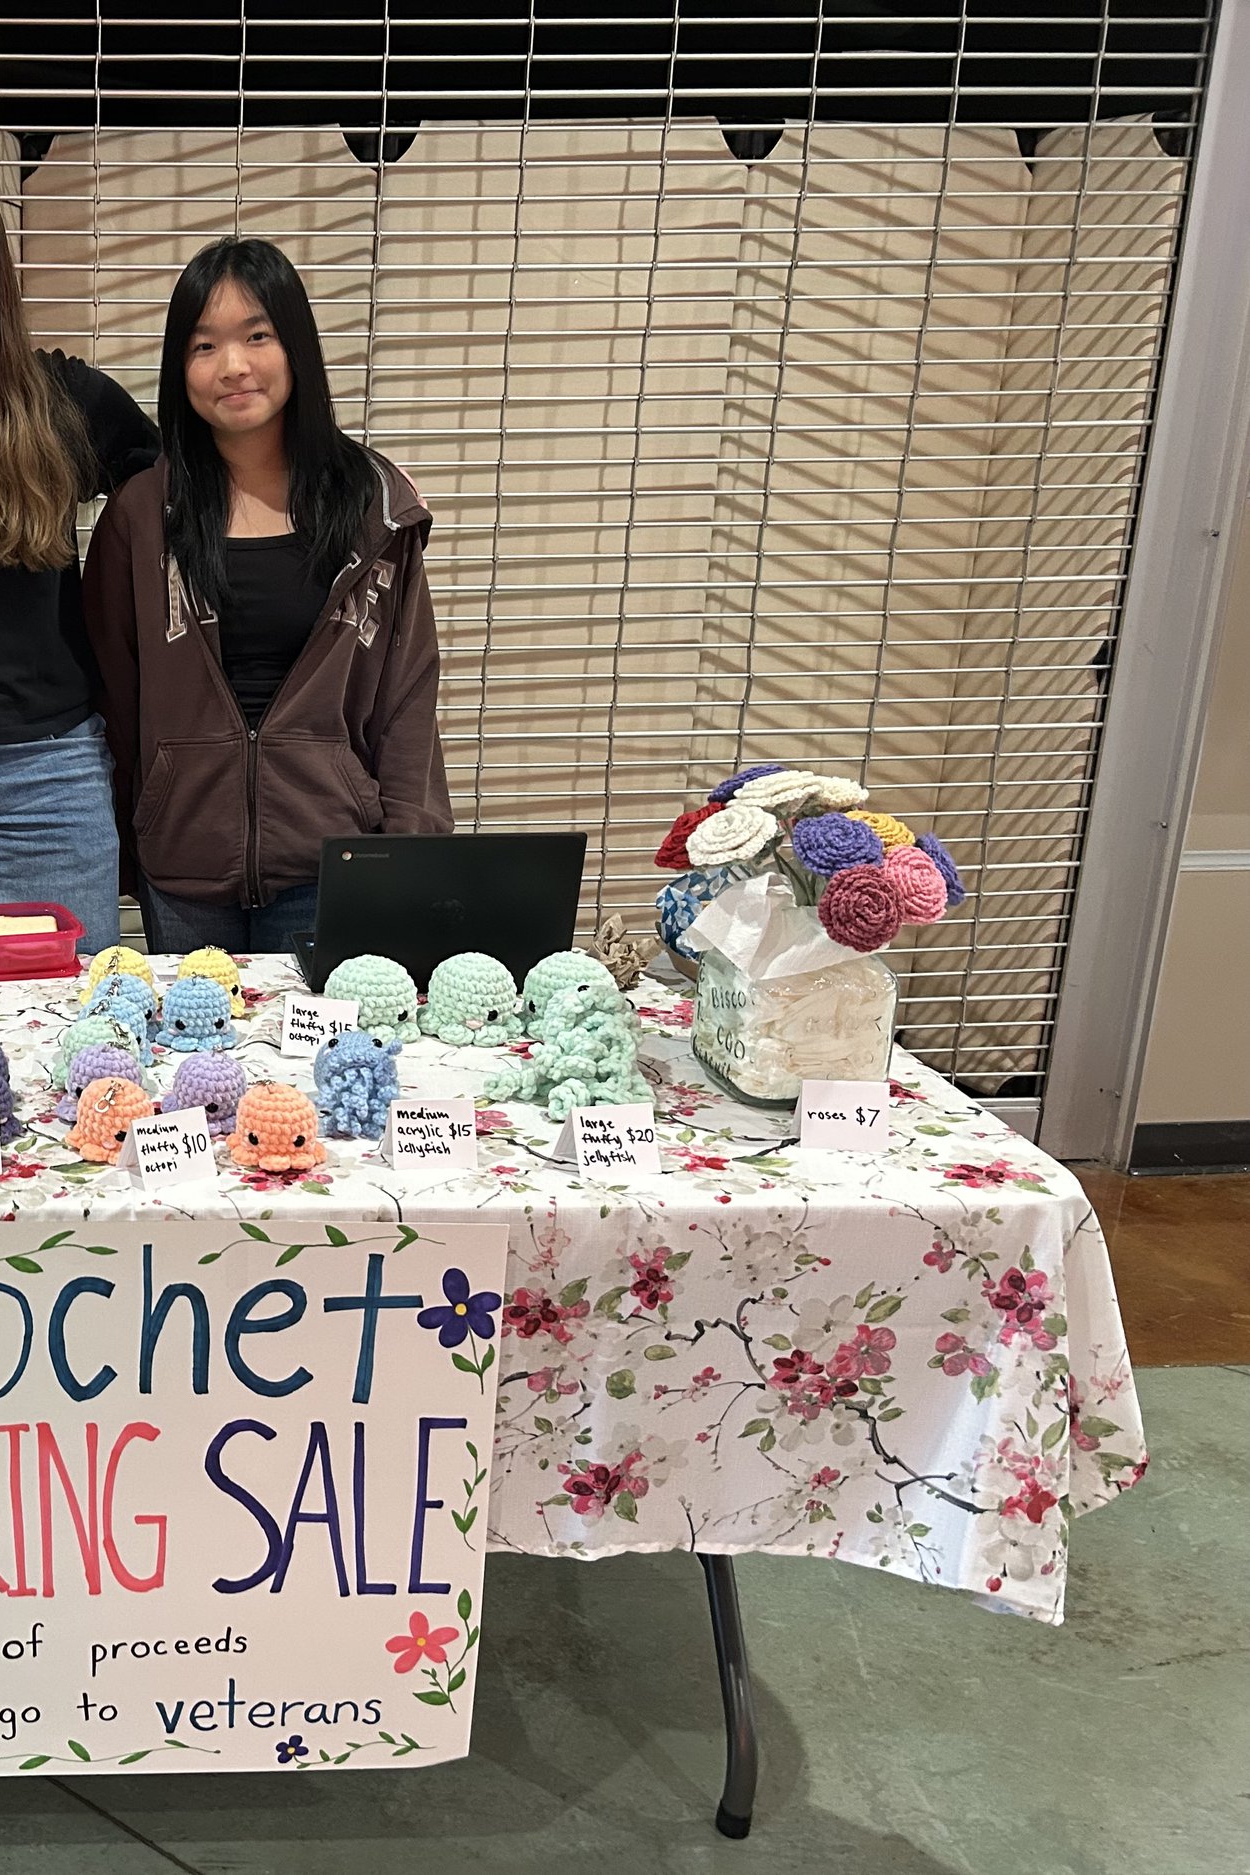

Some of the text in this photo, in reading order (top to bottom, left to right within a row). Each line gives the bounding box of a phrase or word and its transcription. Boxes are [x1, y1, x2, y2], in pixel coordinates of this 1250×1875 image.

[291, 1004, 319, 1022] large
[290, 1018, 353, 1036] fluffy $15
[288, 1032, 320, 1046] octopi
[396, 1106, 450, 1120] medium
[807, 1106, 881, 1128] roses $7
[136, 1124, 179, 1136] medium
[397, 1122, 473, 1140] acrylic $15
[579, 1115, 615, 1133] large
[141, 1132, 207, 1159] fluffy $10
[581, 1127, 654, 1149] fluffy $20
[398, 1140, 451, 1158] jellyfish
[583, 1148, 636, 1168] jellyfish
[145, 1159, 178, 1173] octopi
[204, 1417, 468, 1596] SALE
[0, 1622, 45, 1662] of
[88, 1626, 250, 1678] proceeds
[75, 1693, 120, 1724] to
[153, 1677, 384, 1735] veterans
